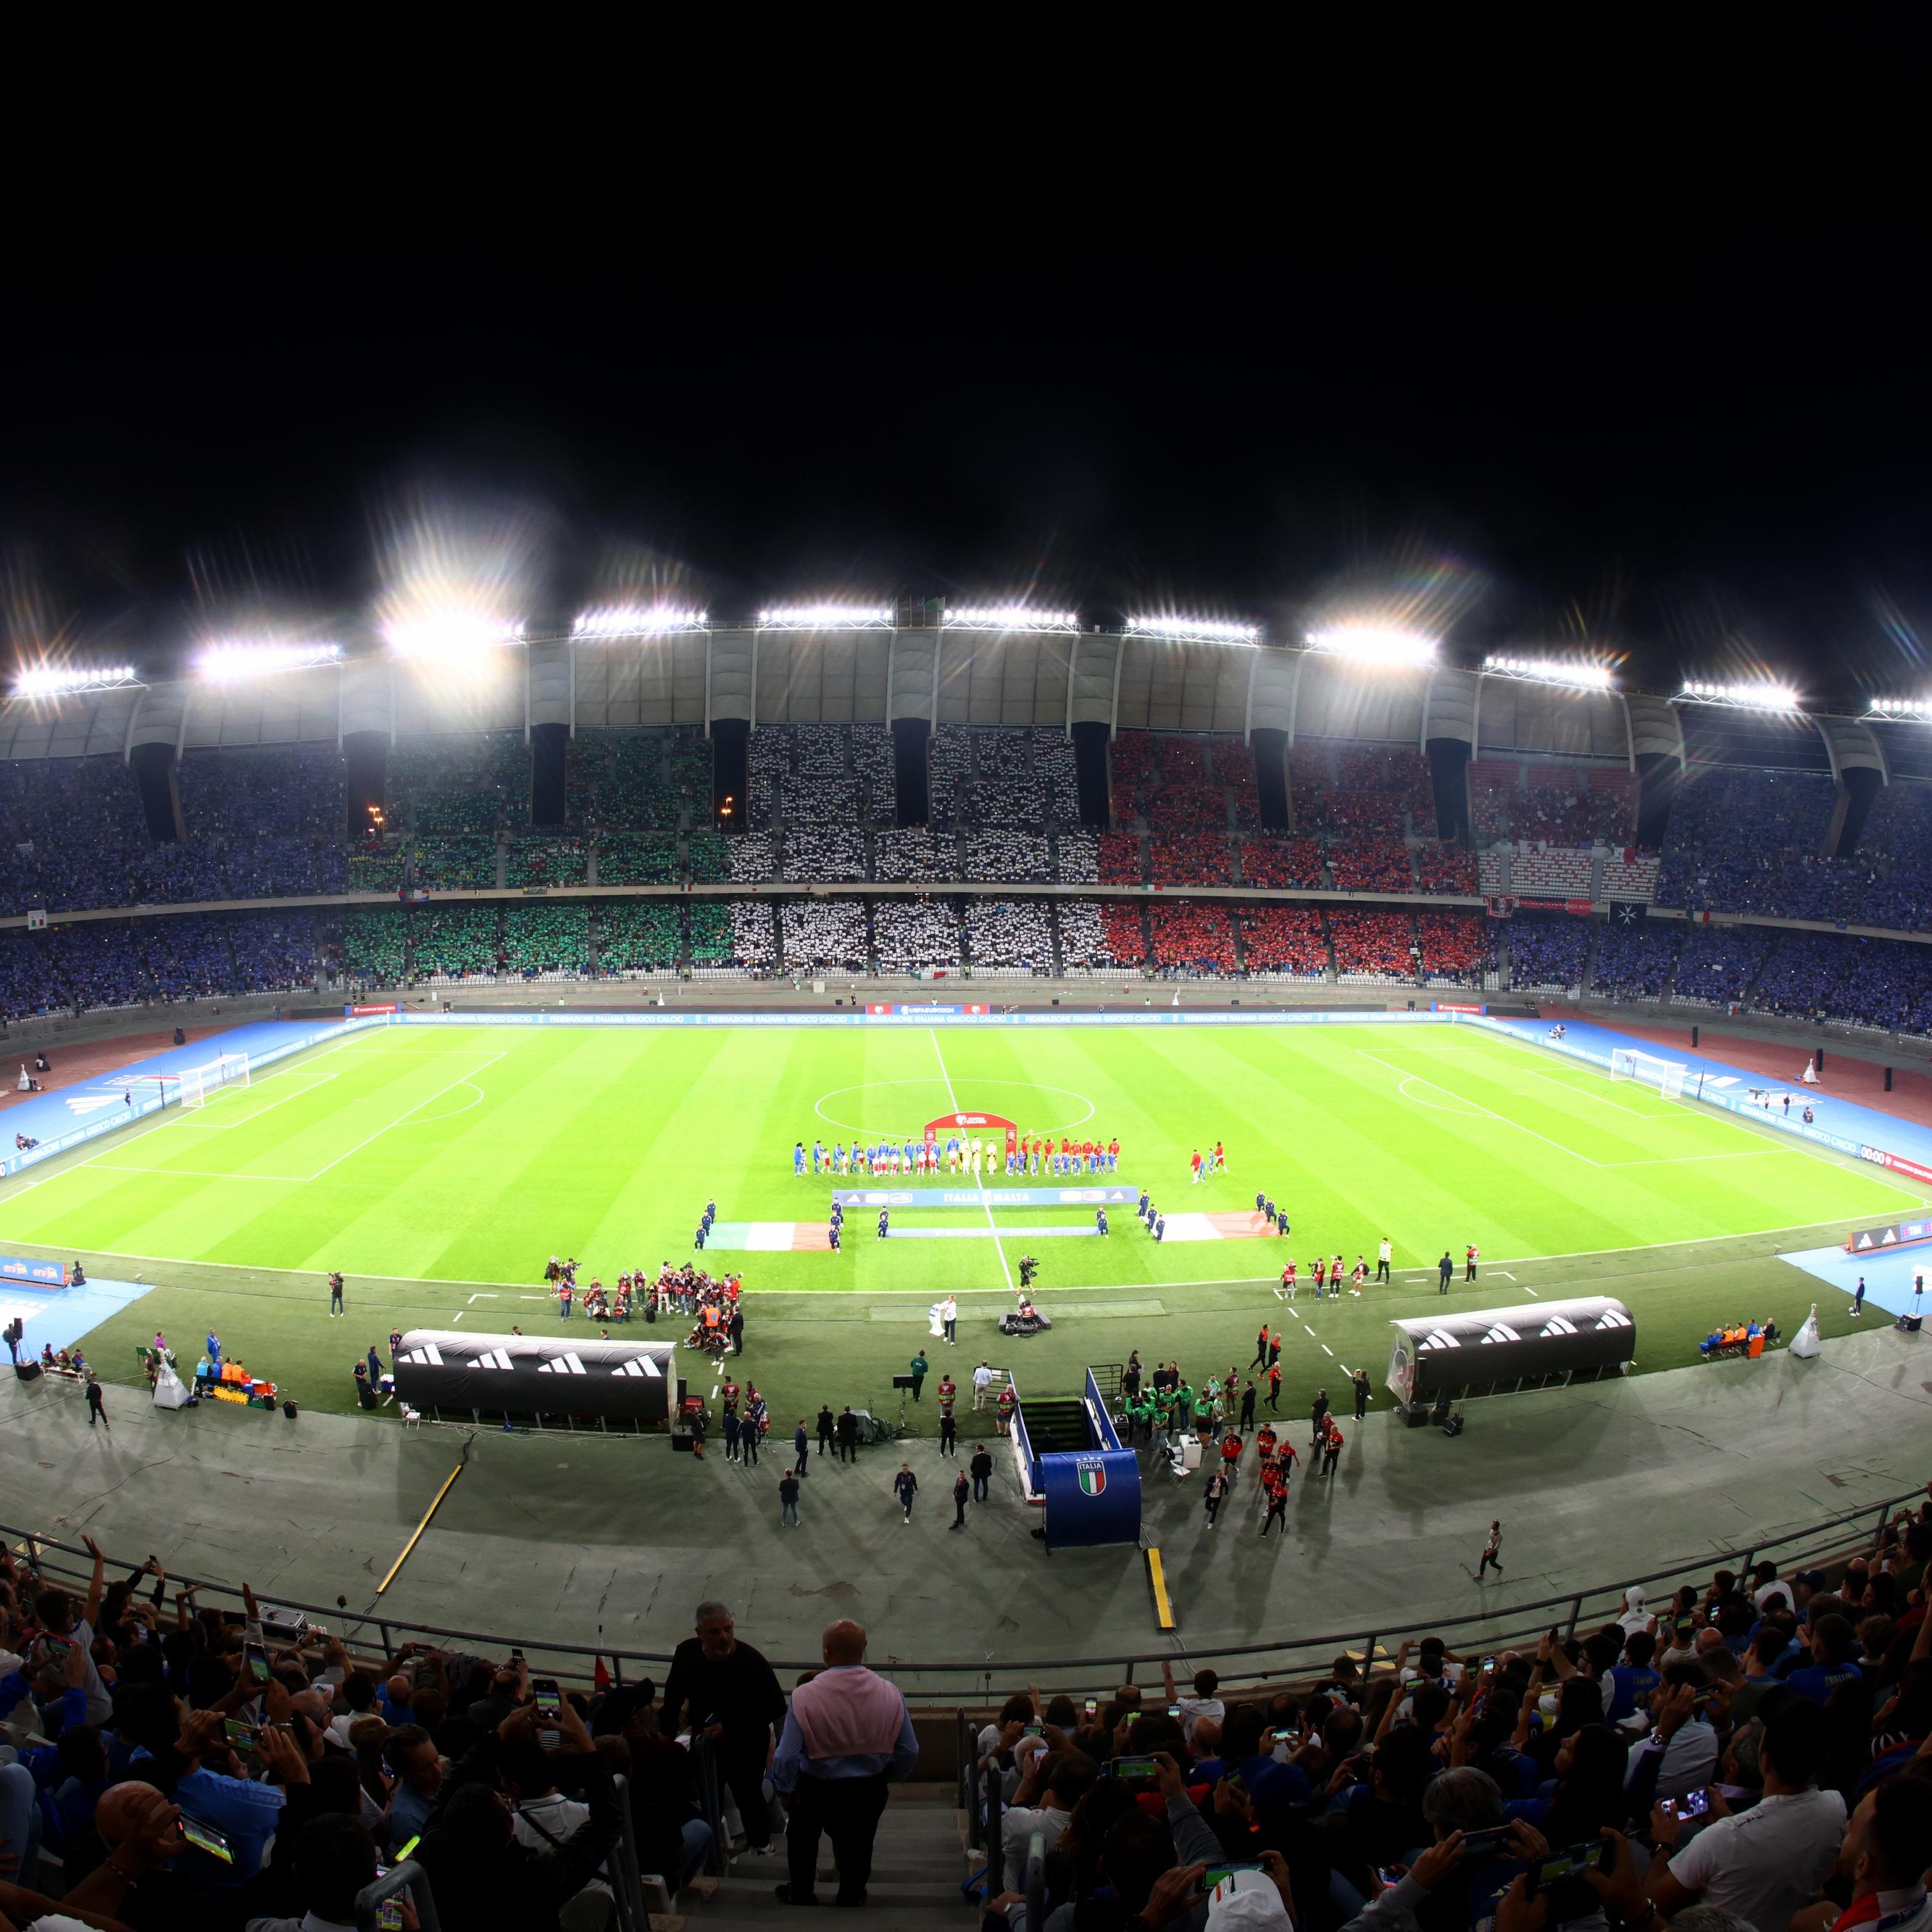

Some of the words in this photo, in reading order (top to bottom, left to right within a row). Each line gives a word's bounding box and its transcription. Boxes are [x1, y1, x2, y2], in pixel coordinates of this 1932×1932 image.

[1861, 1145, 1885, 1165] 00:00
[944, 1193, 979, 1203] ITALIA
[994, 1193, 1030, 1202] MALTA
[4, 1265, 17, 1273] eni
[33, 1267, 46, 1278] eni
